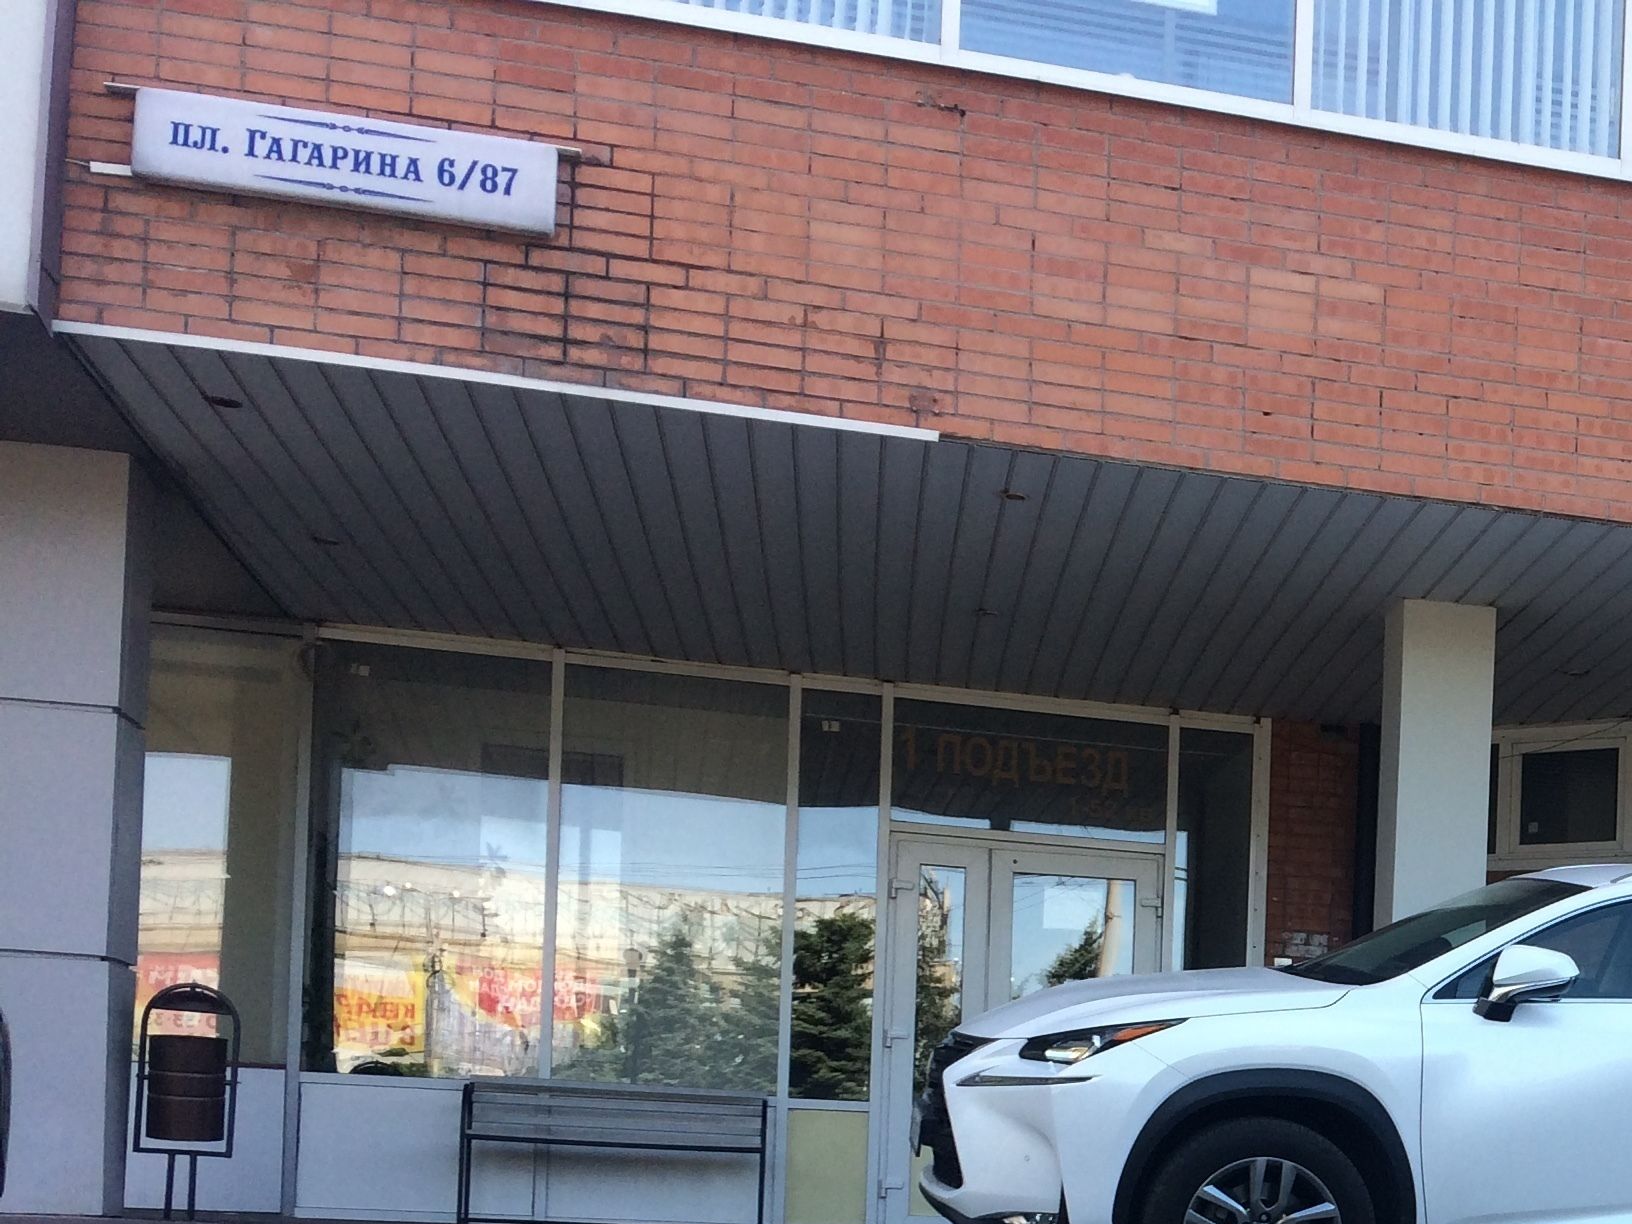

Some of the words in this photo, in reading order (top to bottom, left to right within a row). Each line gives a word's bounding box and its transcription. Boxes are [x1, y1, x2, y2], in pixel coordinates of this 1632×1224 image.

[244, 128, 424, 182] ГАГАРИНА
[437, 157, 519, 196] 6/87
[902, 725, 919, 769] 1
[935, 733, 1129, 797] ПОДЪЕЗД
